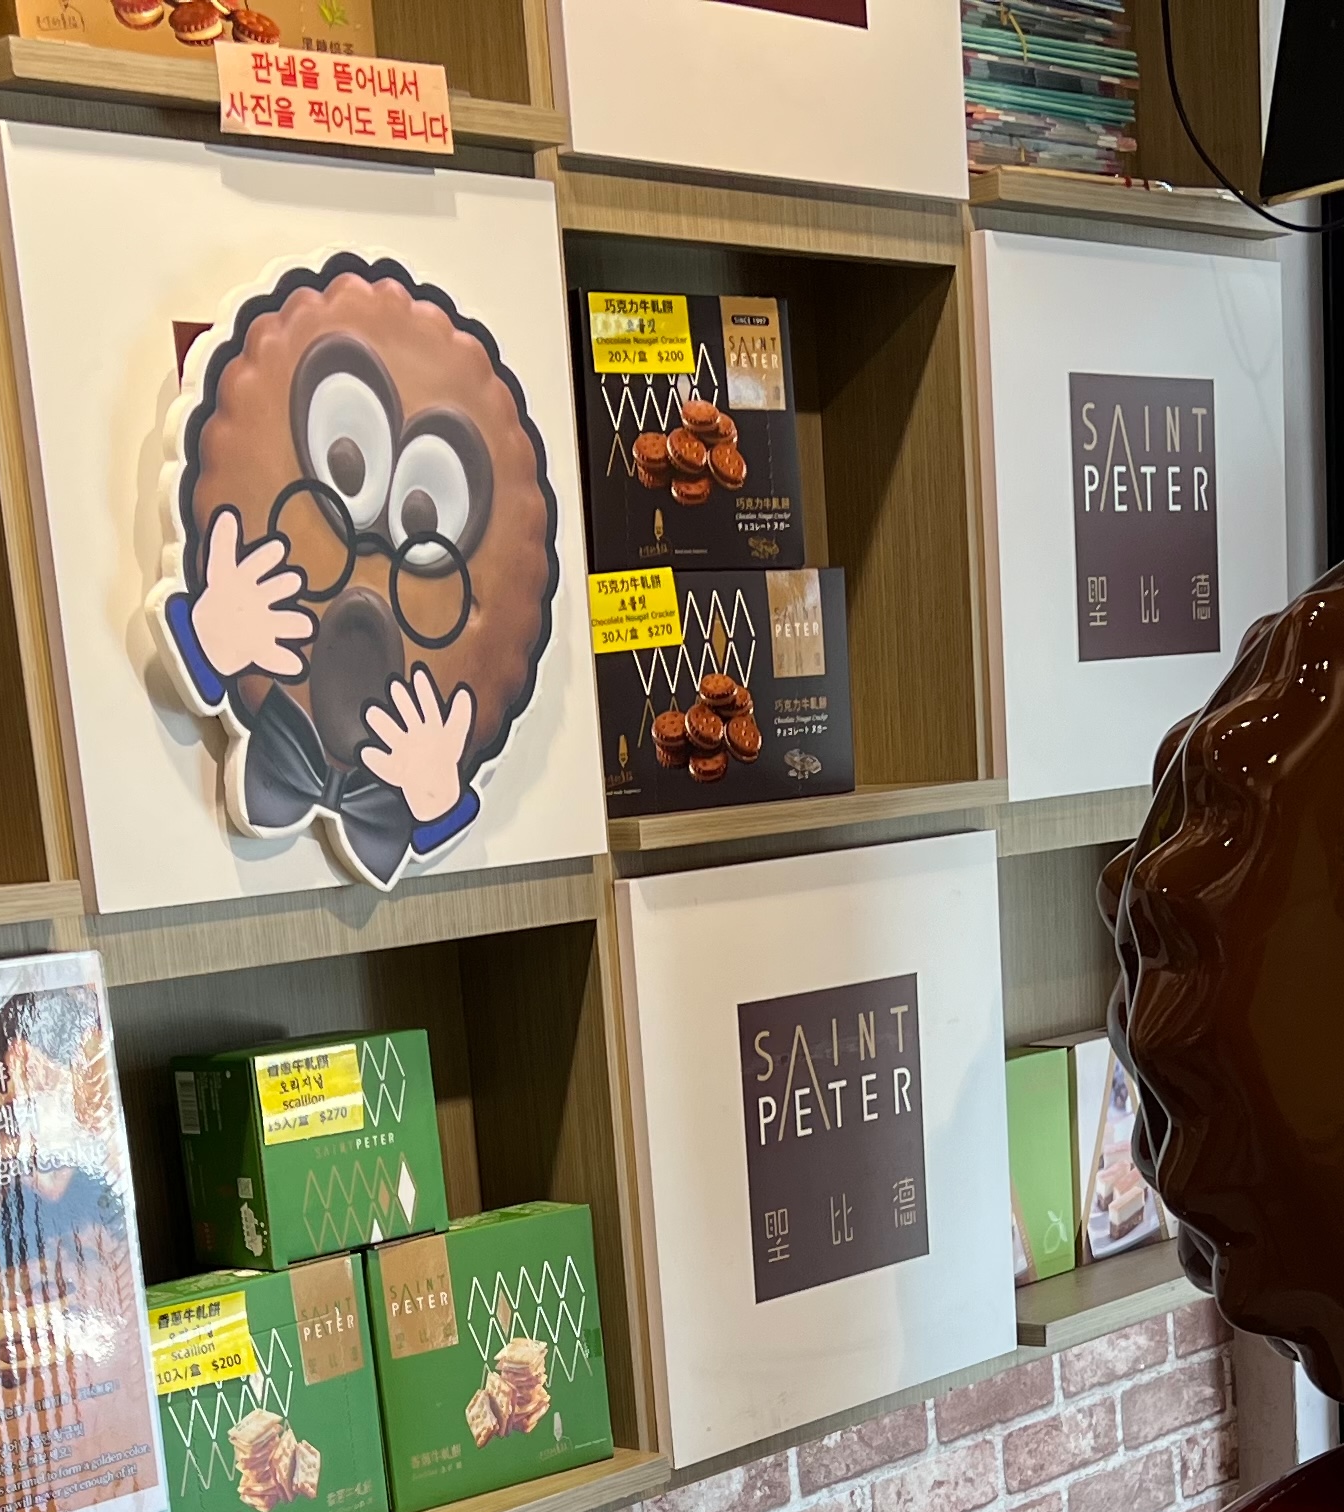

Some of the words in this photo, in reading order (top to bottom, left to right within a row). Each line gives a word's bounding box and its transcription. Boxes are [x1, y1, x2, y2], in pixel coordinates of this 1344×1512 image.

[251, 51, 320, 89] 판넬을
[333, 60, 420, 102] 뜯어내서
[225, 92, 296, 129] 사진을
[309, 104, 376, 137] 찍어도
[386, 106, 449, 146] 됩니다
[657, 350, 684, 363] $200
[730, 353, 779, 368] PETER
[1084, 464, 1208, 512] PETER
[647, 624, 673, 639] $270
[775, 622, 819, 639] PETER
[283, 1092, 326, 1111] scallion
[758, 1067, 912, 1146] PETER
[319, 1106, 348, 1124] $270
[391, 1291, 448, 1317] PETER
[304, 1314, 355, 1341] PETER
[211, 1353, 242, 1372] $200
[6, 1474, 46, 1494] caramel
[47, 1472, 58, 1483] to
[58, 1464, 82, 1480] form
[90, 1452, 123, 1472] golden
[15, 1495, 33, 1510] will
[34, 1487, 62, 1503] never
[63, 1484, 77, 1500] get
[77, 1473, 115, 1495] enough
